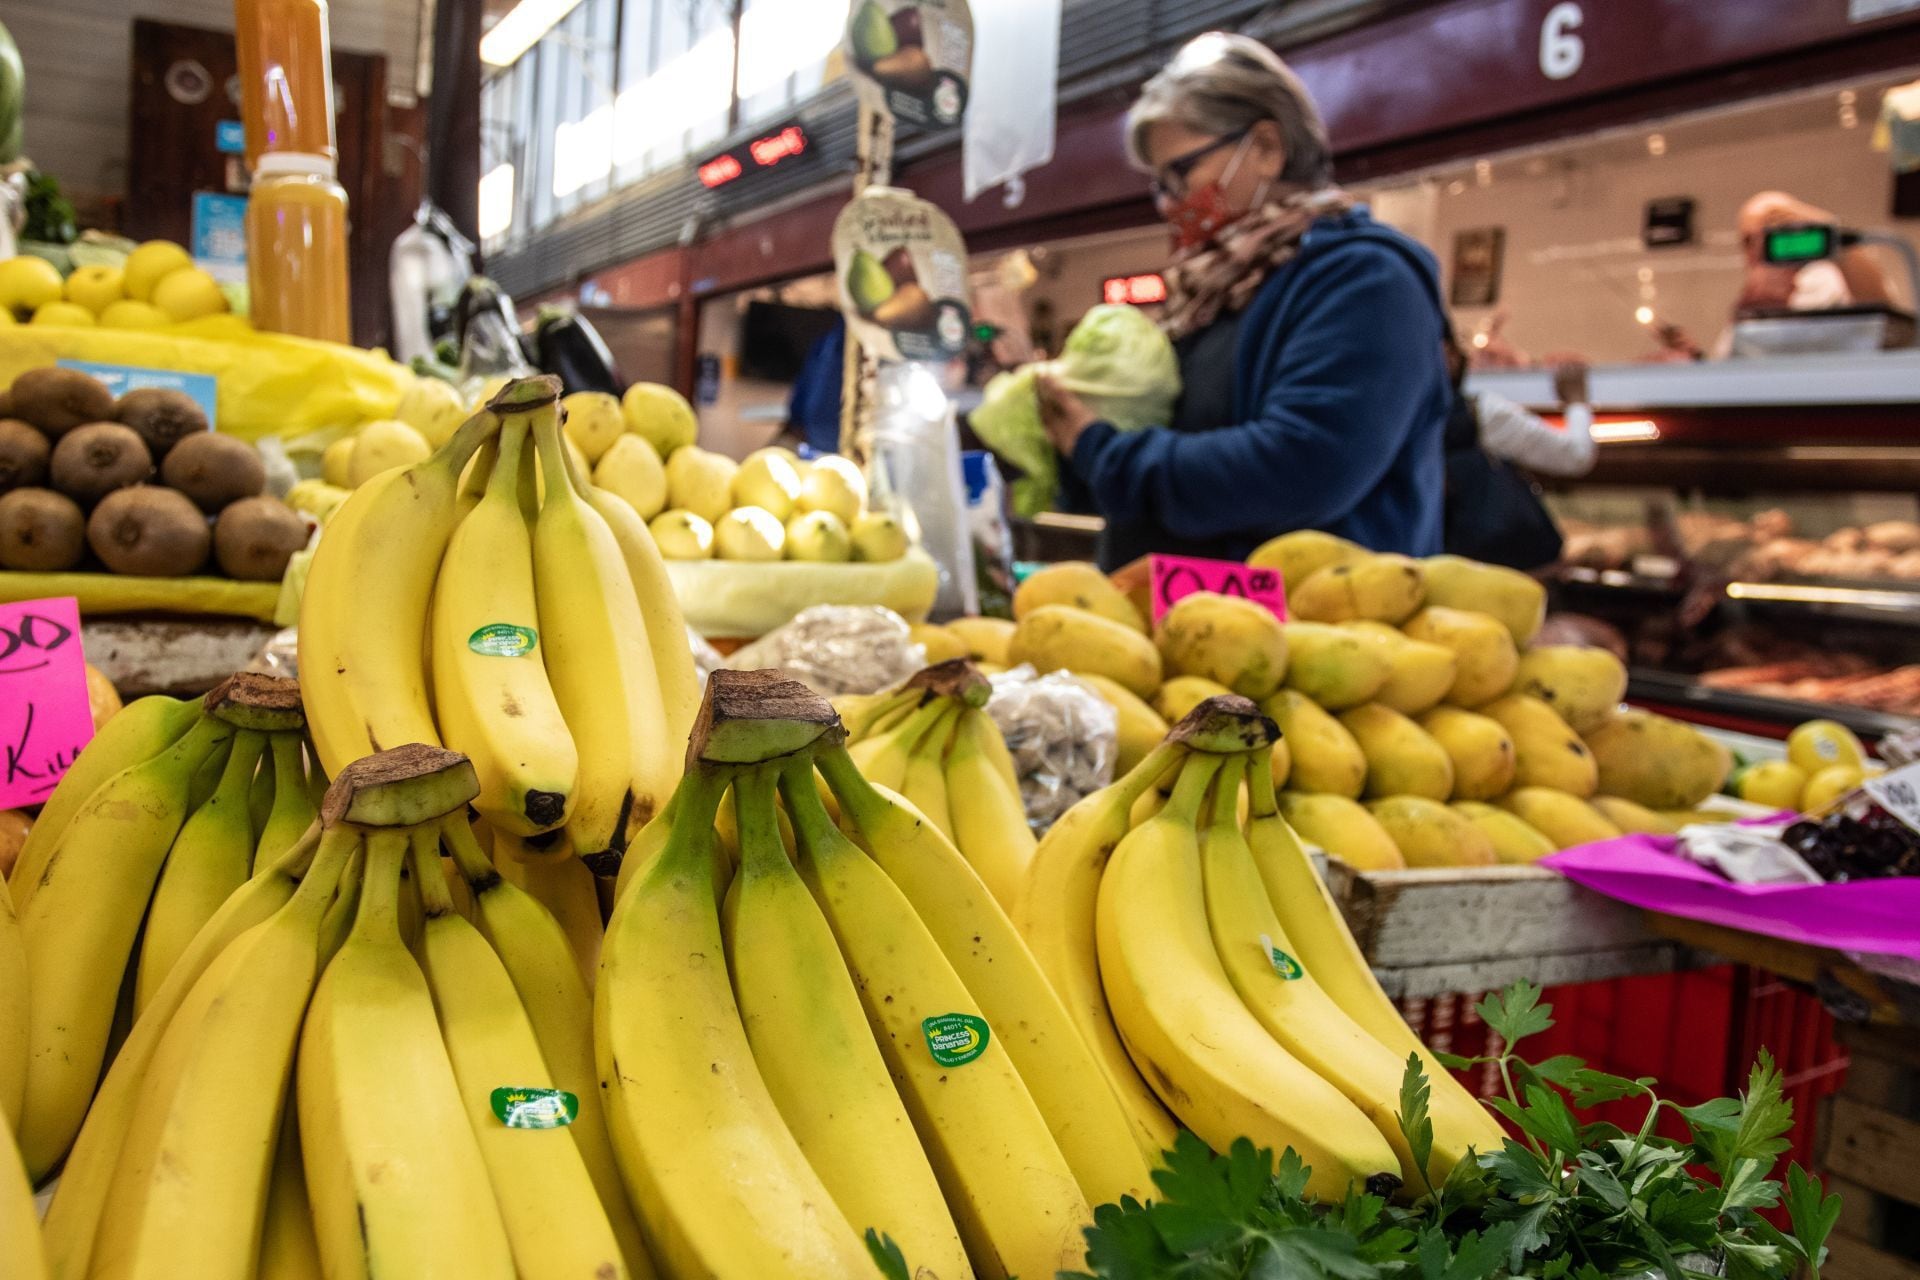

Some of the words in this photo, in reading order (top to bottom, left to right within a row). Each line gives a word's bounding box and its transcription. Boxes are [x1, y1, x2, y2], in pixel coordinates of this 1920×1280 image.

[1539, 2, 1584, 79] 6
[934, 1030, 970, 1043] PRINCESS
[931, 1038, 971, 1050] bananas
